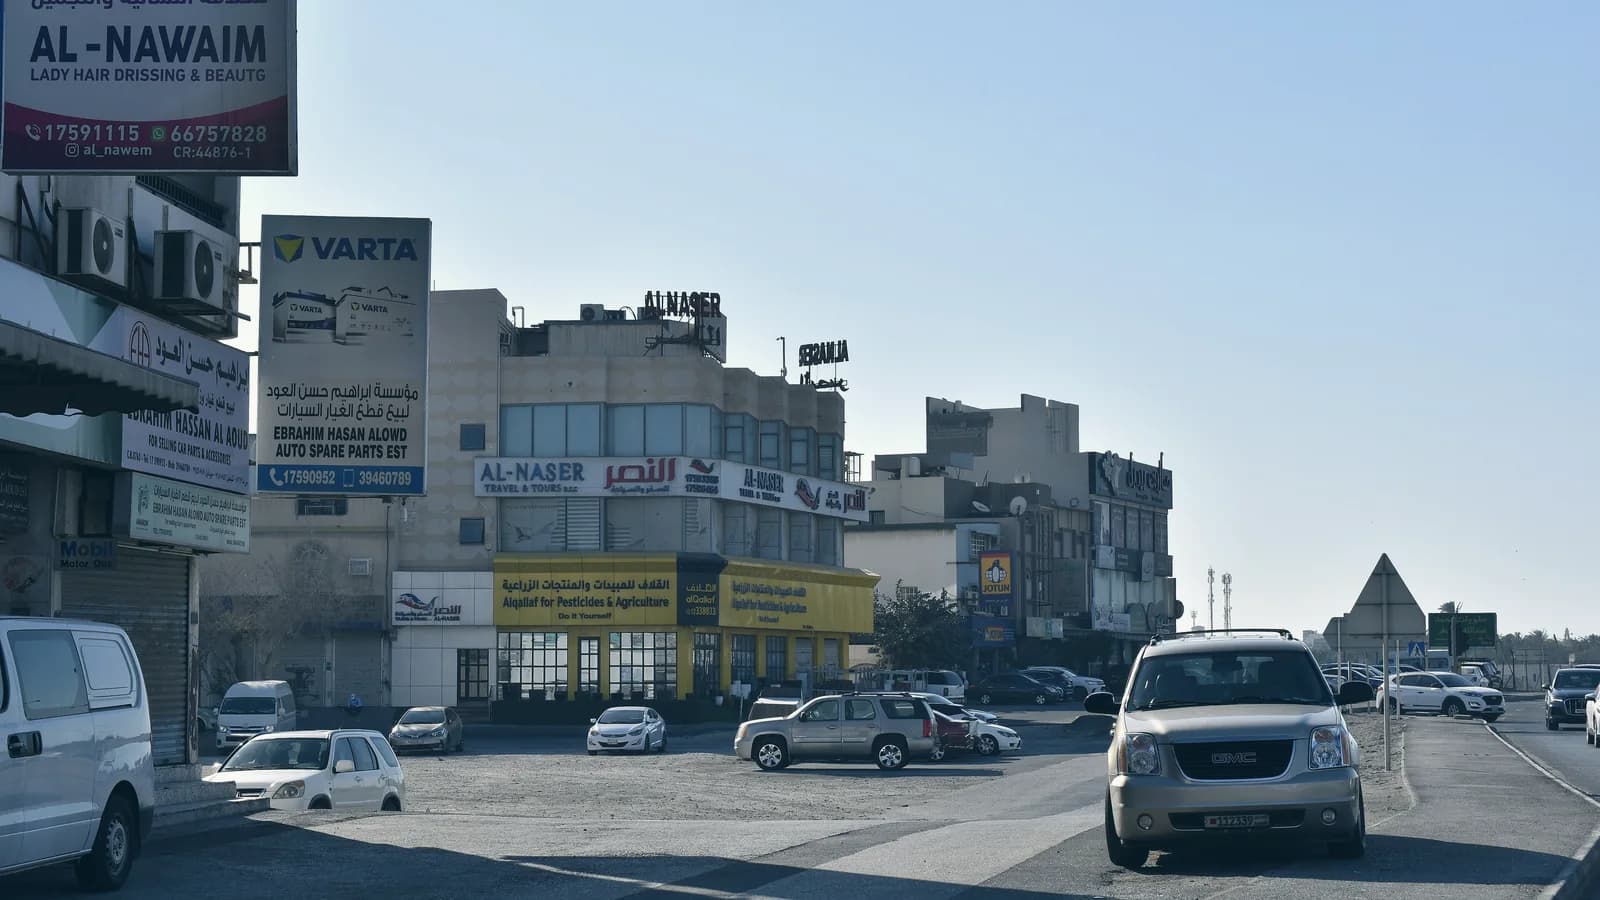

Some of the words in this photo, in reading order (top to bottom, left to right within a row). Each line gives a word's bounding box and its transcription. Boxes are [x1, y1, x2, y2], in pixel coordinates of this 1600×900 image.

[30, 69, 69, 81] LADY
[74, 69, 109, 81] HAIR
[114, 69, 186, 81] DRISSING
[191, 69, 200, 81] &
[205, 69, 265, 81] BEAUTG
[46, 125, 139, 141] 17591115
[171, 126, 266, 142] 66757828
[83, 144, 152, 157] al_nawem
[174, 146, 250, 159] CR:44876-1
[312, 237, 418, 261] VARTA
[299, 305, 323, 314] VARTA
[361, 304, 388, 314] VARTA
[266, 383, 296, 400] العود
[299, 383, 329, 400] حسن
[331, 384, 371, 401] ابراهيم
[374, 382, 419, 400] مؤسسة
[278, 403, 323, 421] السيارات
[325, 403, 353, 421] الغيار
[355, 402, 383, 421] قطع
[386, 403, 410, 422] لبيع
[176, 411, 211, 441] HASSAN
[214, 423, 223, 444] AL
[226, 426, 248, 450] AOUD
[274, 426, 324, 441] EBRAHIM
[328, 427, 365, 441] HASAN
[368, 428, 407, 441] ALOWD
[148, 434, 158, 447] FOR
[178, 441, 187, 455] CAR
[276, 444, 306, 457] AUTO
[309, 444, 345, 458] SPARE
[348, 445, 383, 459] PARTS
[386, 445, 407, 459] EST
[283, 470, 335, 484] 17590952
[359, 471, 411, 485] 39460789
[480, 462, 584, 482] AL-NASER
[604, 458, 676, 489] النصر
[485, 484, 520, 493] TRAVEL
[531, 484, 562, 493] TOURS
[60, 541, 113, 557] Mobil
[61, 560, 89, 569] Motor
[502, 579, 539, 593] الزراعية
[638, 579, 670, 590] القلاف
[983, 584, 1010, 593] JOTUN
[540, 596, 554, 608] for
[557, 596, 605, 608] Pesticides
[607, 597, 613, 608] &
[615, 596, 669, 609] Agriculture
[1212, 752, 1257, 764] GMC
